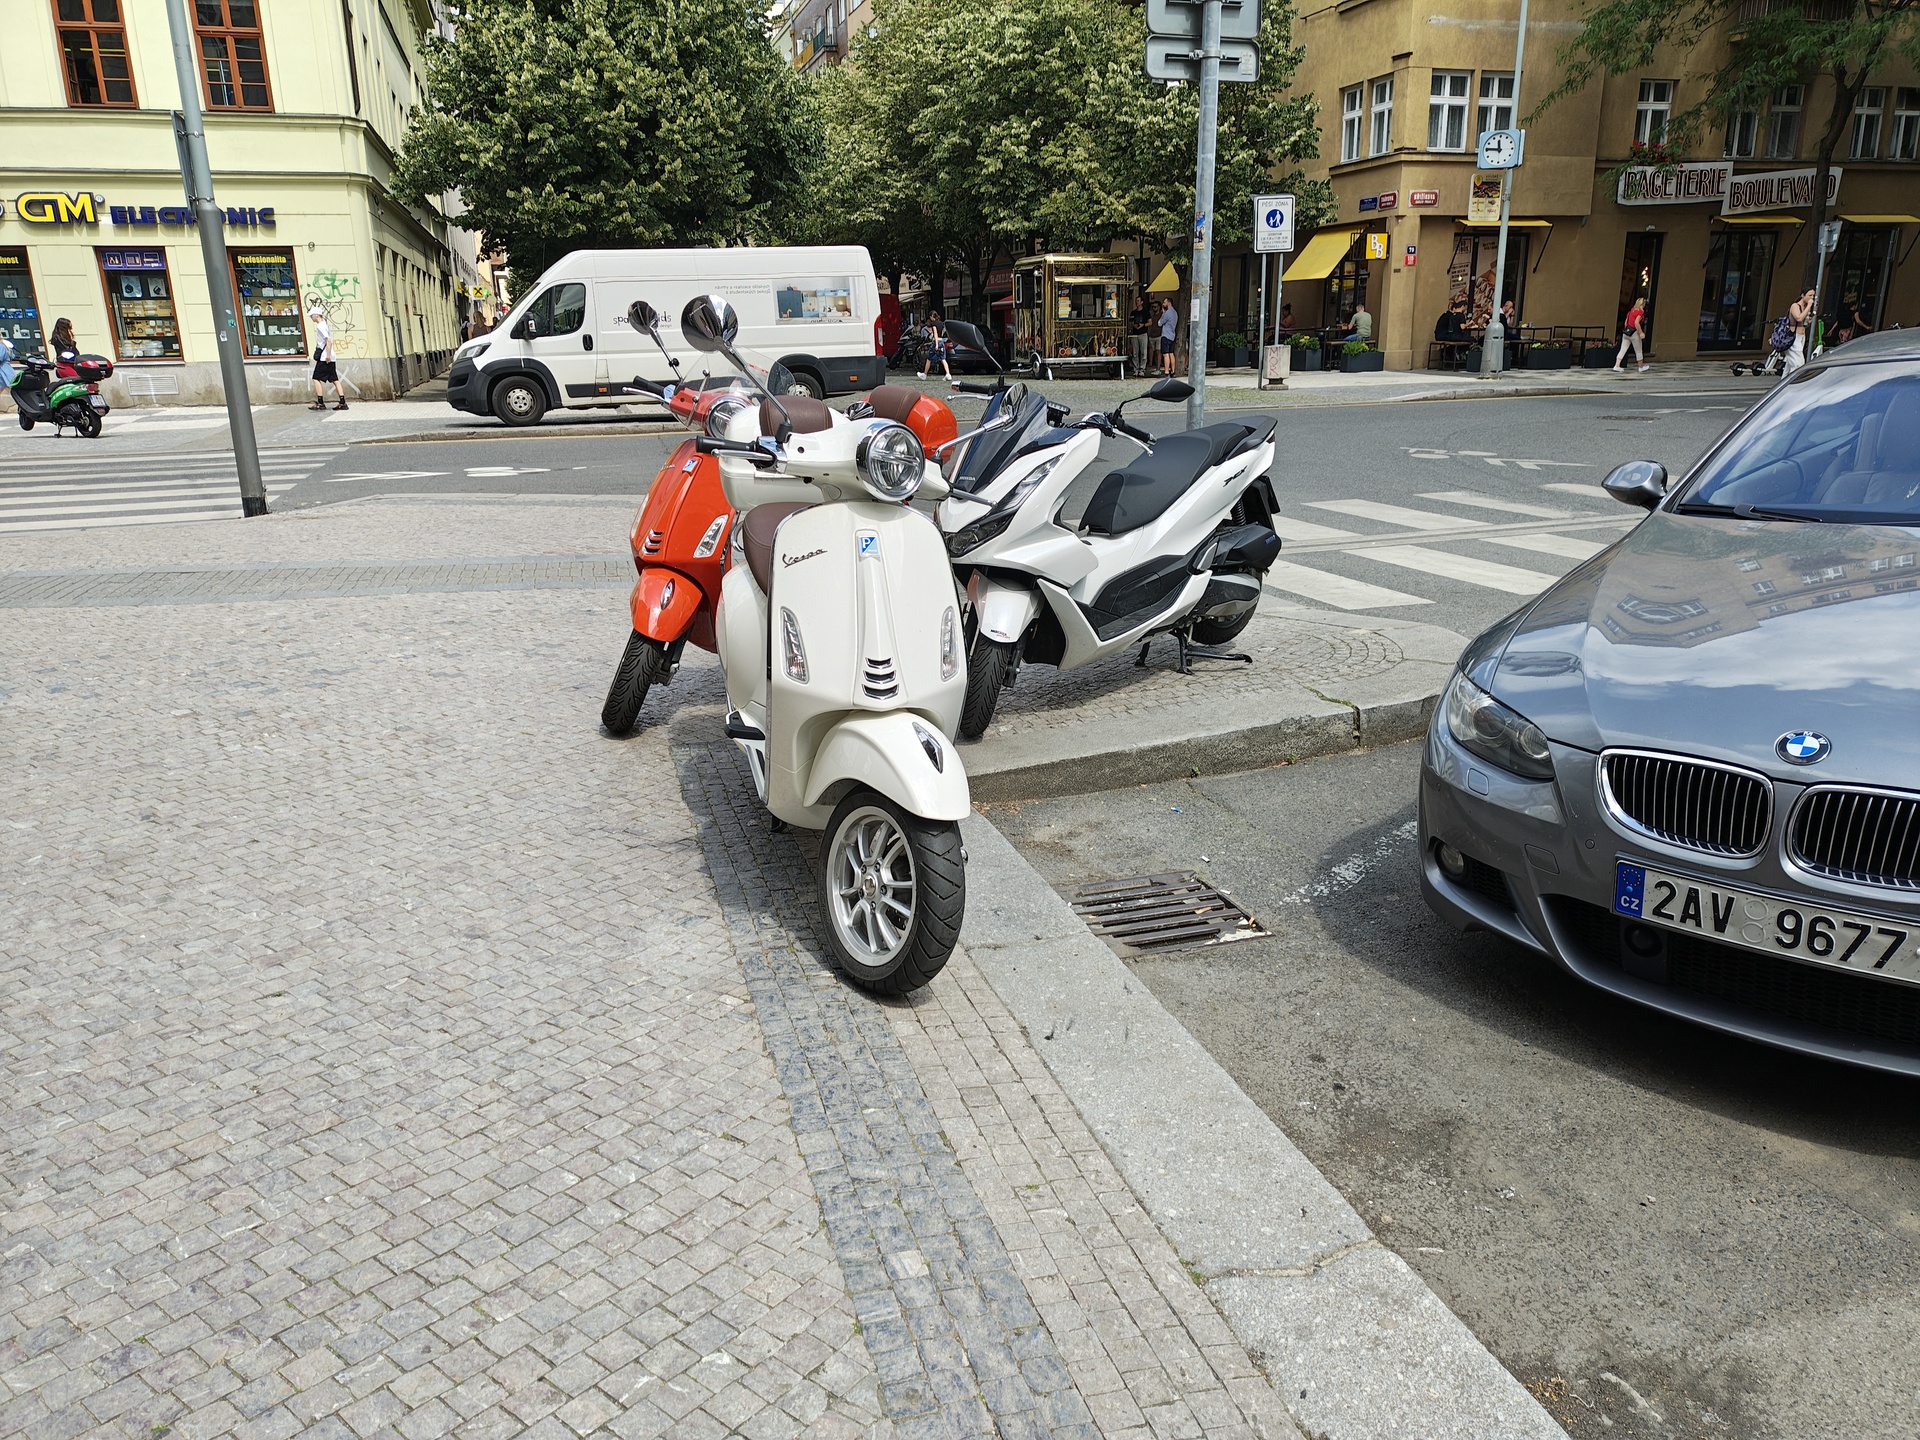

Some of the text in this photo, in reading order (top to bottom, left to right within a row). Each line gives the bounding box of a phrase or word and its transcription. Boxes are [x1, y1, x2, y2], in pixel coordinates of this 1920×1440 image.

[1624, 168, 1729, 199] BAGETERIE
[1729, 175, 1837, 210] BOULEVAD
[17, 192, 275, 226] GM ELECTNIC
[237, 255, 286, 263] Profesionalita
[862, 537, 871, 549] P
[782, 548, 828, 568] Vespa
[1786, 731, 1828, 744] BMW
[1620, 895, 1639, 911] CZ
[1651, 879, 1908, 970] 2AV 9677
